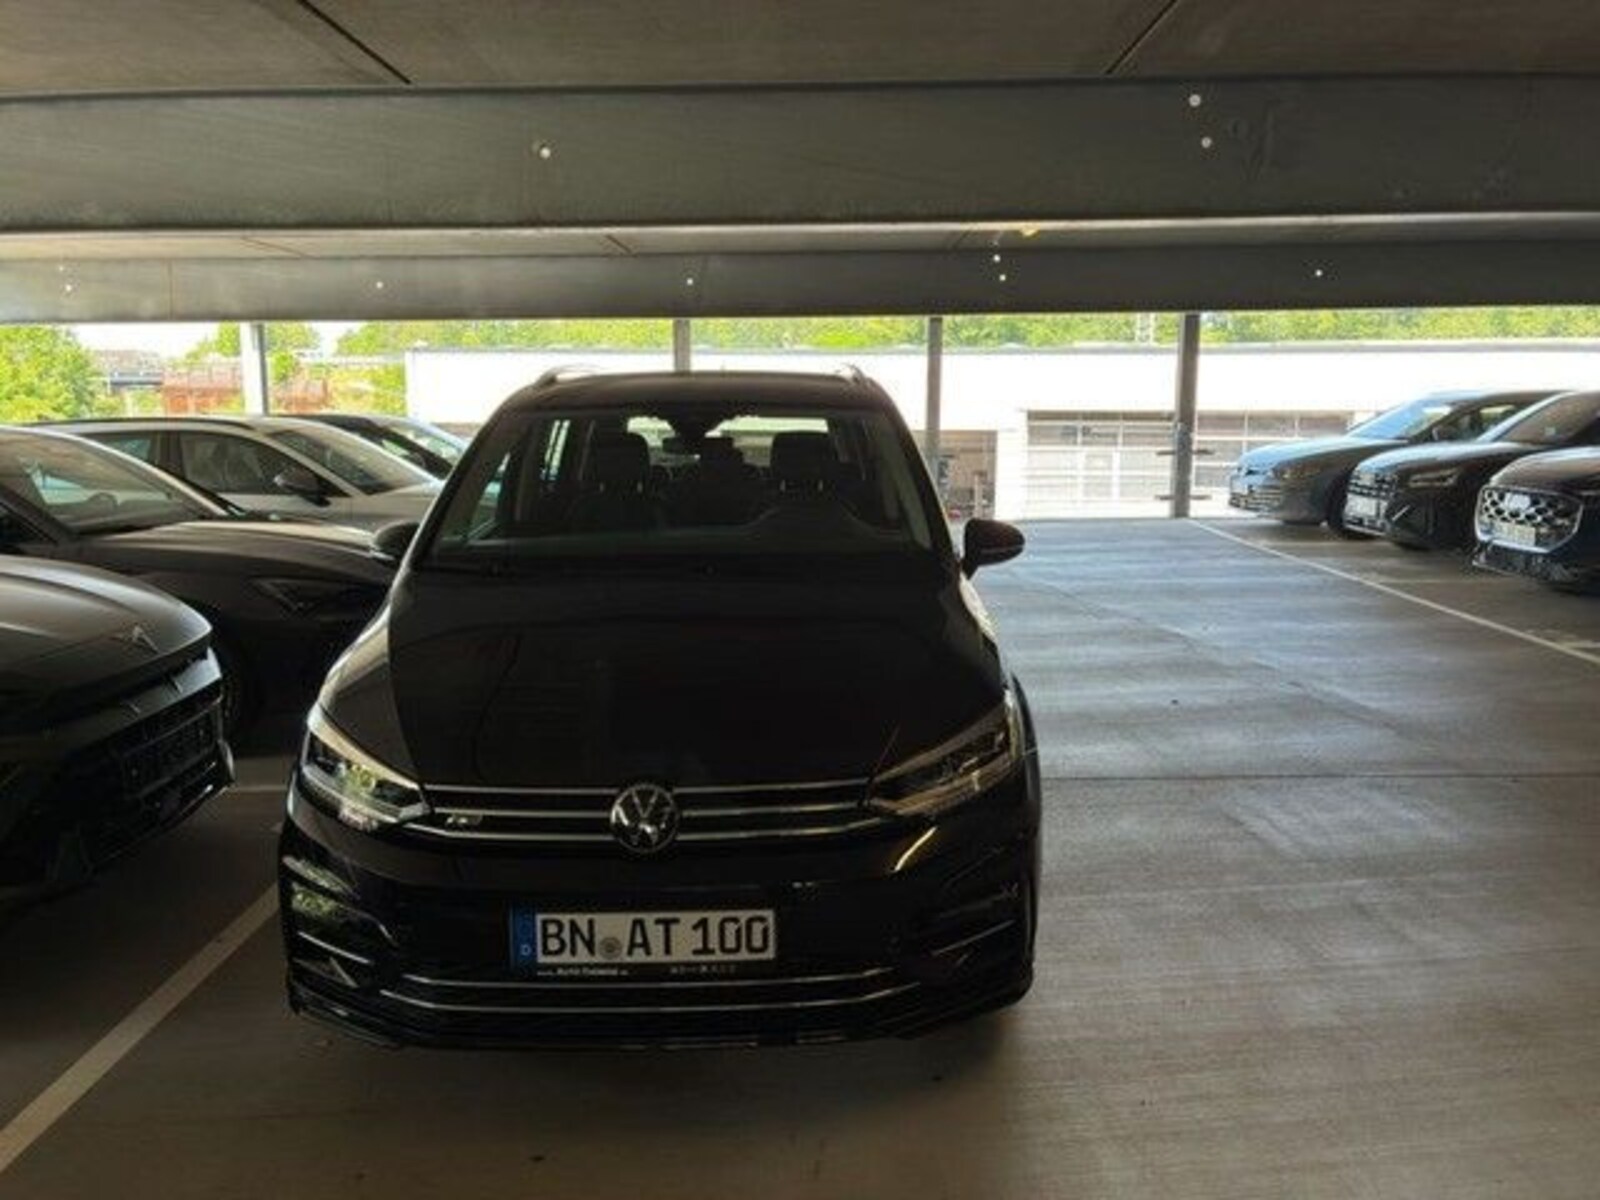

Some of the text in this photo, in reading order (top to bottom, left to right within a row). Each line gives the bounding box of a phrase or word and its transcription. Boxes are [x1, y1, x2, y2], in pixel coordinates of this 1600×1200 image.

[540, 915, 769, 957] BN AT 100
